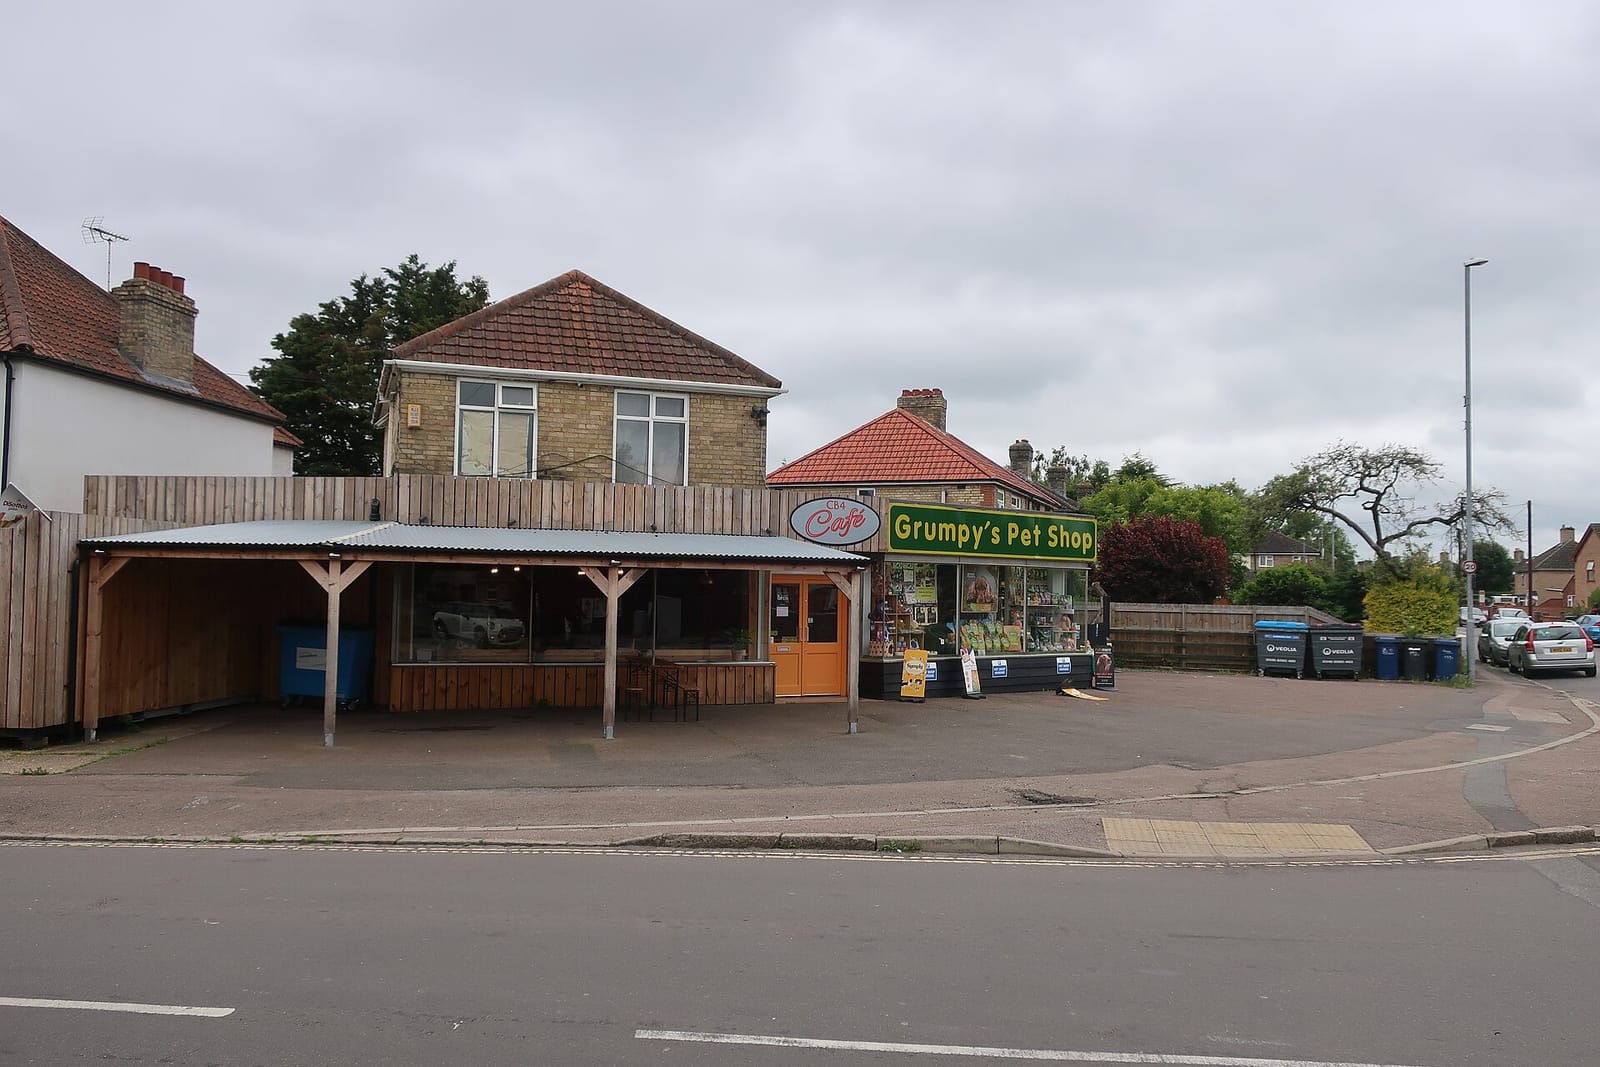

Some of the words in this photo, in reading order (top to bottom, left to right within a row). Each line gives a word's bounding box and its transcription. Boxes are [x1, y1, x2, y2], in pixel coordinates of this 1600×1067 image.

[826, 500, 846, 510] CB4
[805, 507, 866, 538] Café
[895, 513, 1000, 550] Grumpy's
[1007, 522, 1041, 547] Pet
[1047, 524, 1093, 555] Shop
